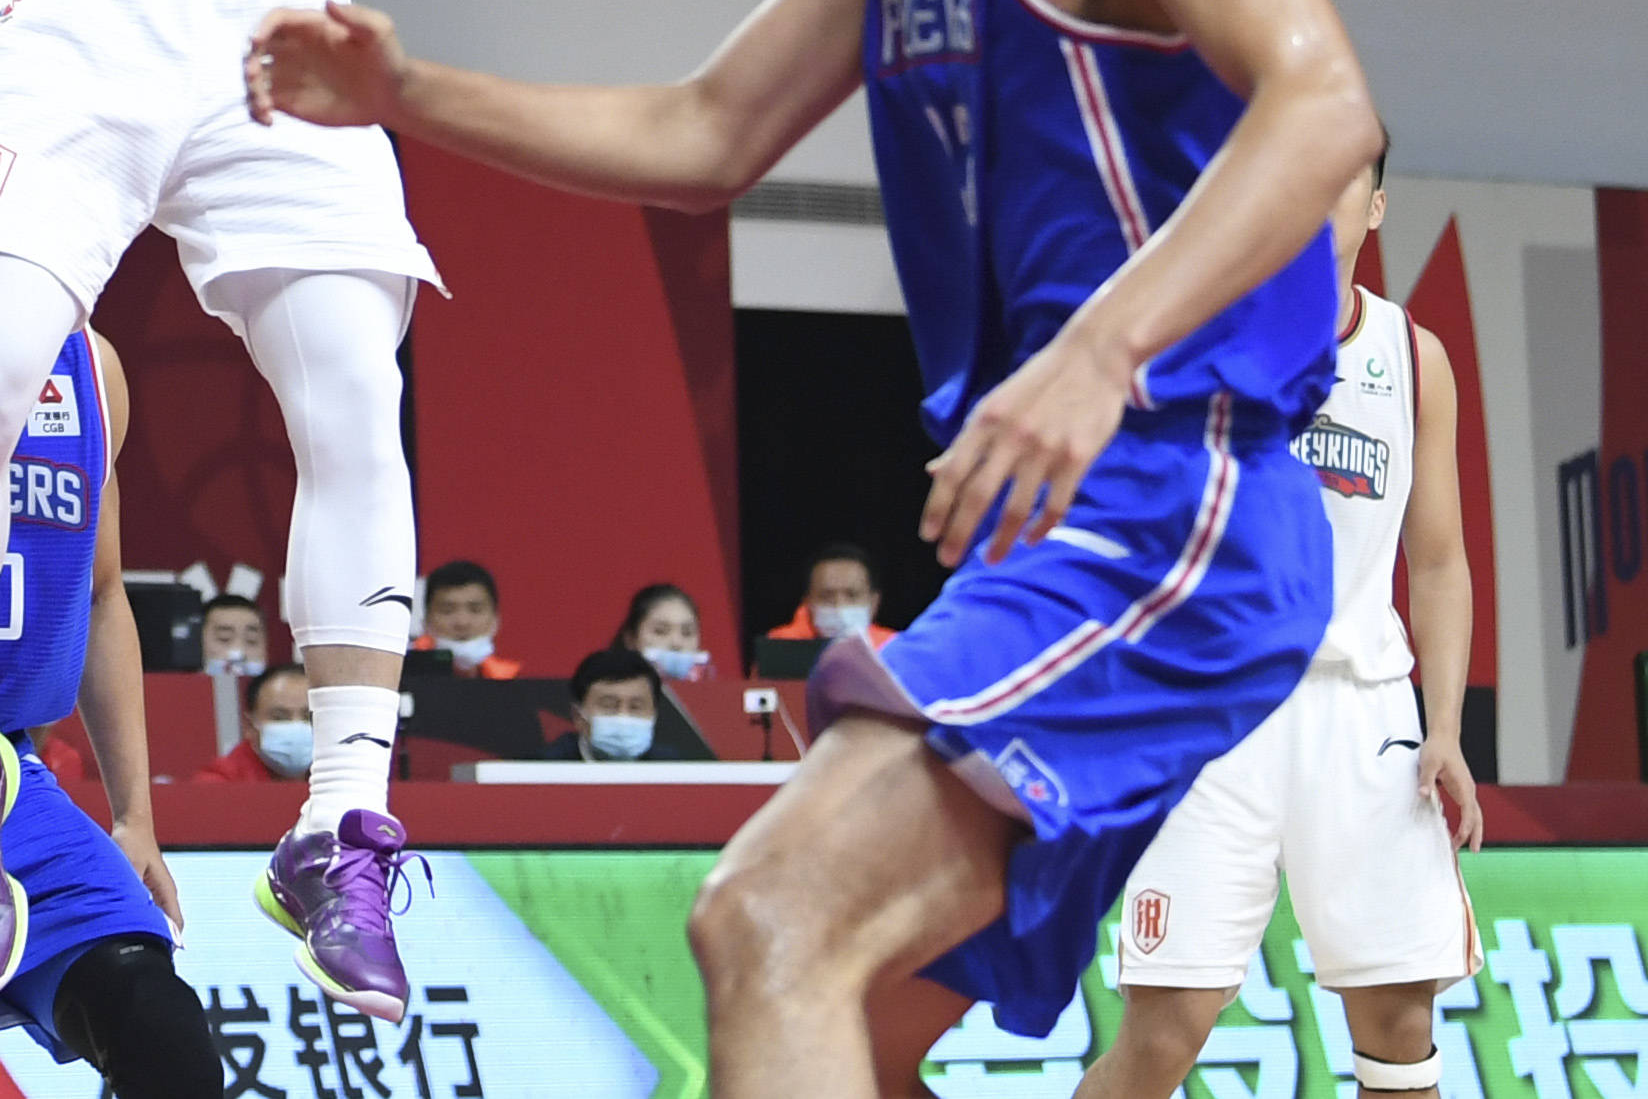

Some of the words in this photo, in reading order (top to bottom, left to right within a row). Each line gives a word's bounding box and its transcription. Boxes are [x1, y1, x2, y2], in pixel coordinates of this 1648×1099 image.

[42, 422, 65, 433] CGB
[207, 985, 485, 1099] 发银行
